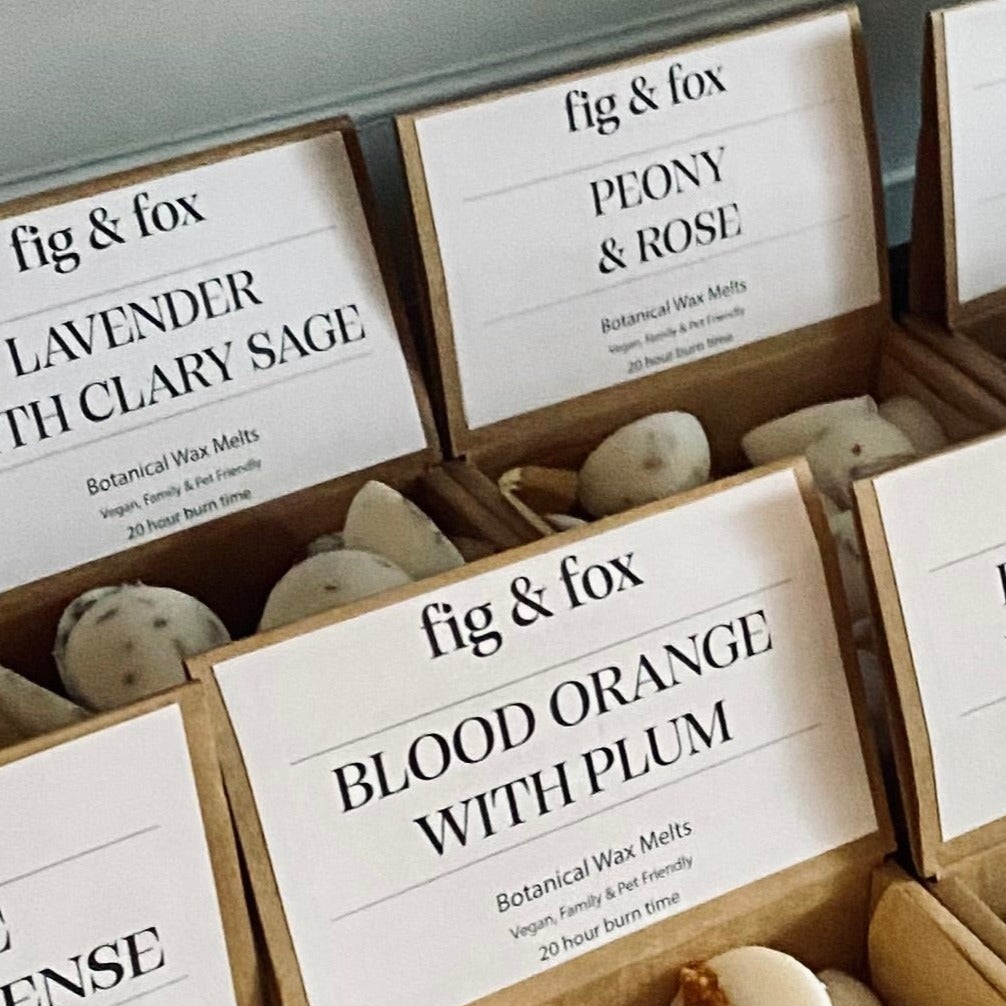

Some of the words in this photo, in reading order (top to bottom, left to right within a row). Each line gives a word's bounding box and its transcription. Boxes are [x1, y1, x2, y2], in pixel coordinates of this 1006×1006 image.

[564, 90, 621, 136] fig
[629, 75, 659, 116] &
[668, 63, 727, 105] fox
[589, 146, 726, 217] PEONY
[10, 225, 81, 274] fig
[89, 206, 125, 249] &
[133, 192, 206, 237] fox
[598, 236, 627, 274] &
[637, 202, 743, 263] ROSE
[5, 270, 263, 377] LAVENDER
[601, 300, 671, 334] Botanical
[672, 294, 705, 311] Wax
[707, 280, 748, 300] Melts
[0, 394, 72, 450] TH
[79, 341, 234, 423] CLARY
[246, 305, 366, 370] SAGE
[86, 454, 169, 496] Botanical
[171, 445, 210, 467] Wax
[212, 429, 260, 454] Melts
[143, 486, 181, 506] Family
[184, 480, 194, 492] &
[194, 474, 214, 488] Pet
[216, 458, 262, 482] Friendly
[127, 523, 145, 540] 20
[147, 512, 182, 533] hour
[183, 500, 217, 520] burn
[219, 489, 252, 508] time
[420, 602, 503, 661] fig
[510, 575, 555, 627] &
[559, 550, 645, 611] fox
[332, 699, 537, 815] BLOOD
[548, 609, 774, 727] ORANGE
[413, 759, 578, 858] WITH
[579, 699, 734, 796] PLUM
[495, 858, 591, 913] Botanical
[591, 844, 636, 873] Wax
[639, 821, 693, 855] Melts
[509, 915, 557, 940] Vegan,
[559, 893, 603, 921] Family
[605, 887, 616, 901] &
[618, 878, 640, 896] Pet
[642, 855, 694, 885] Friendly
[538, 942, 560, 962] 20
[561, 925, 601, 952] hour
[603, 908, 642, 935] burn
[644, 891, 681, 916] time
